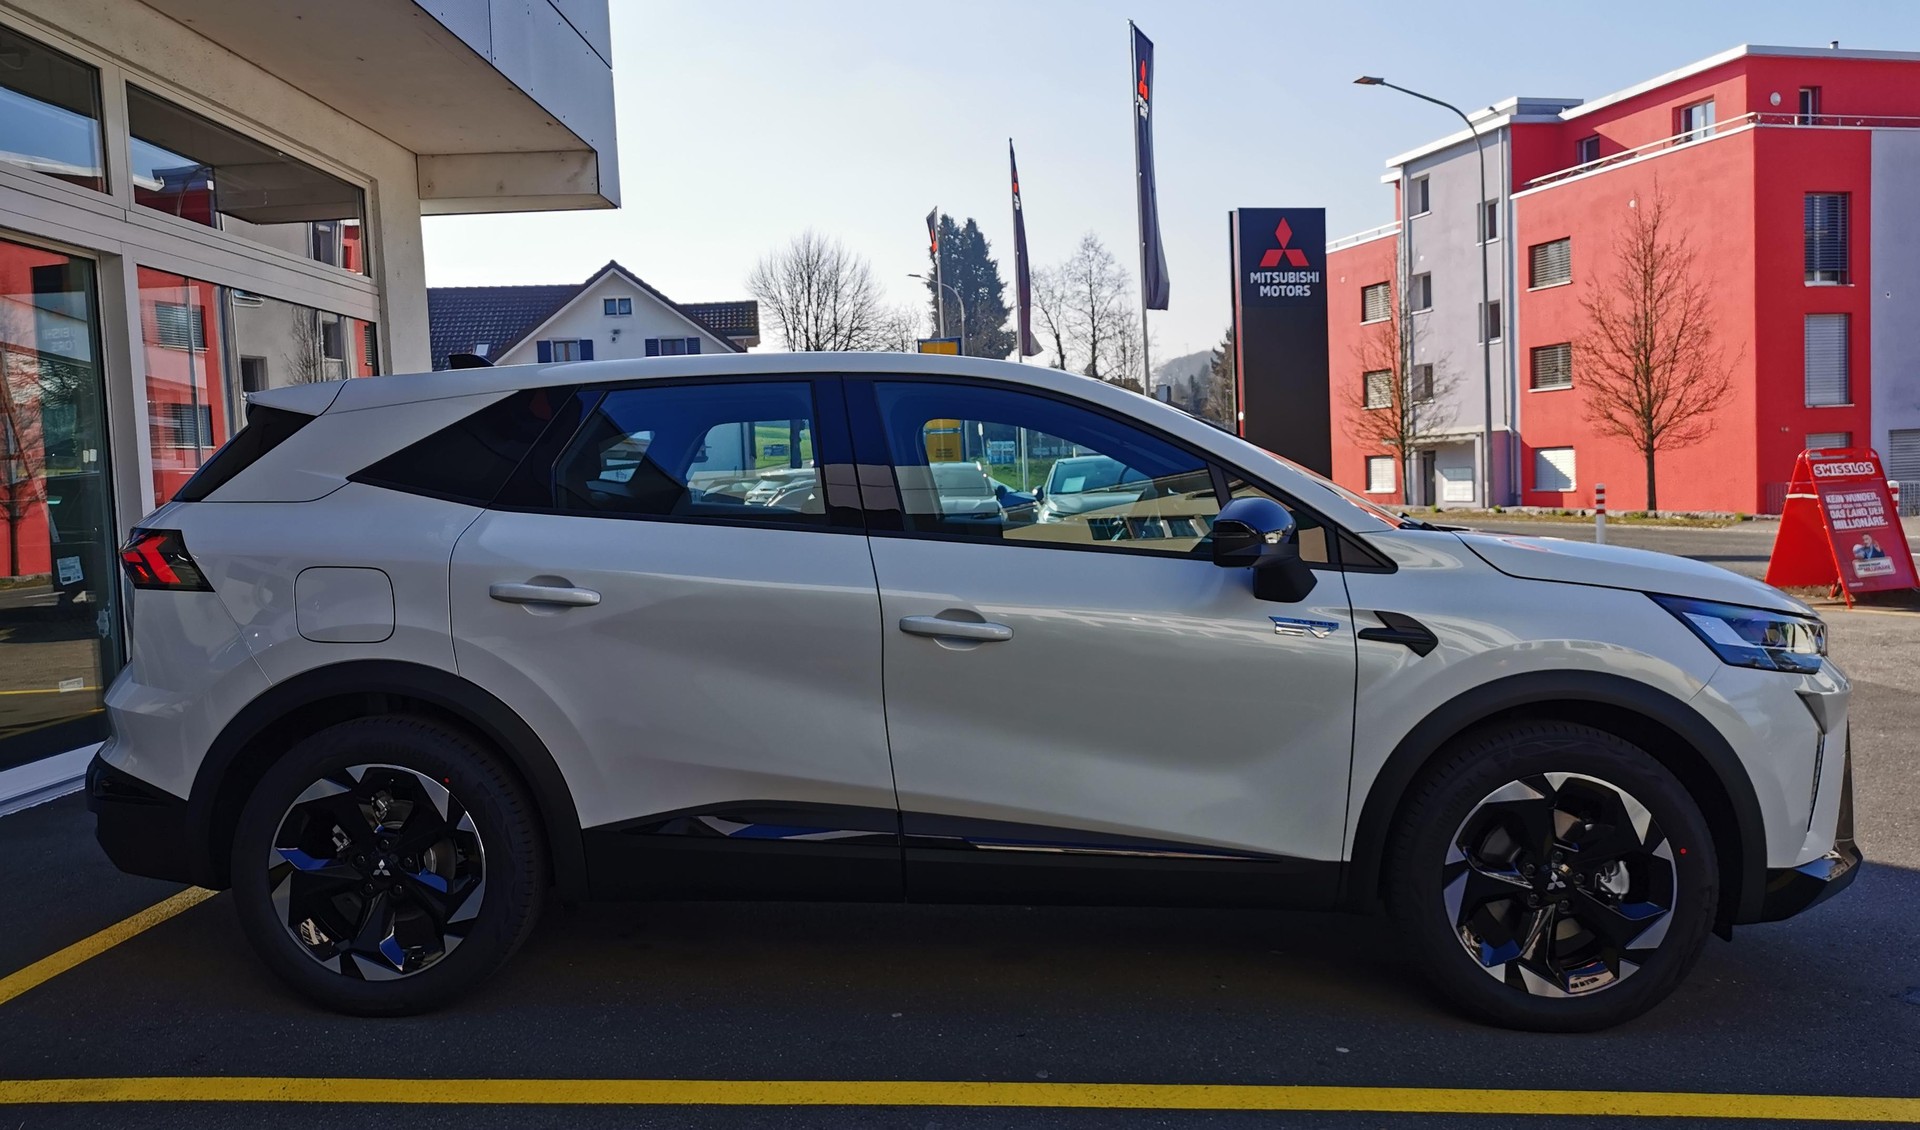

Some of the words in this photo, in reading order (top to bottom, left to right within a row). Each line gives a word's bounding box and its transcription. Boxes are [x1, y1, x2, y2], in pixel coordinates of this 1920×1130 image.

[1250, 271, 1320, 284] MITSUBISHI
[1259, 284, 1312, 297] MOTORS
[1815, 463, 1873, 475] SWISSLOS
[1830, 509, 1846, 519] DAS
[1846, 507, 1867, 518] LAND
